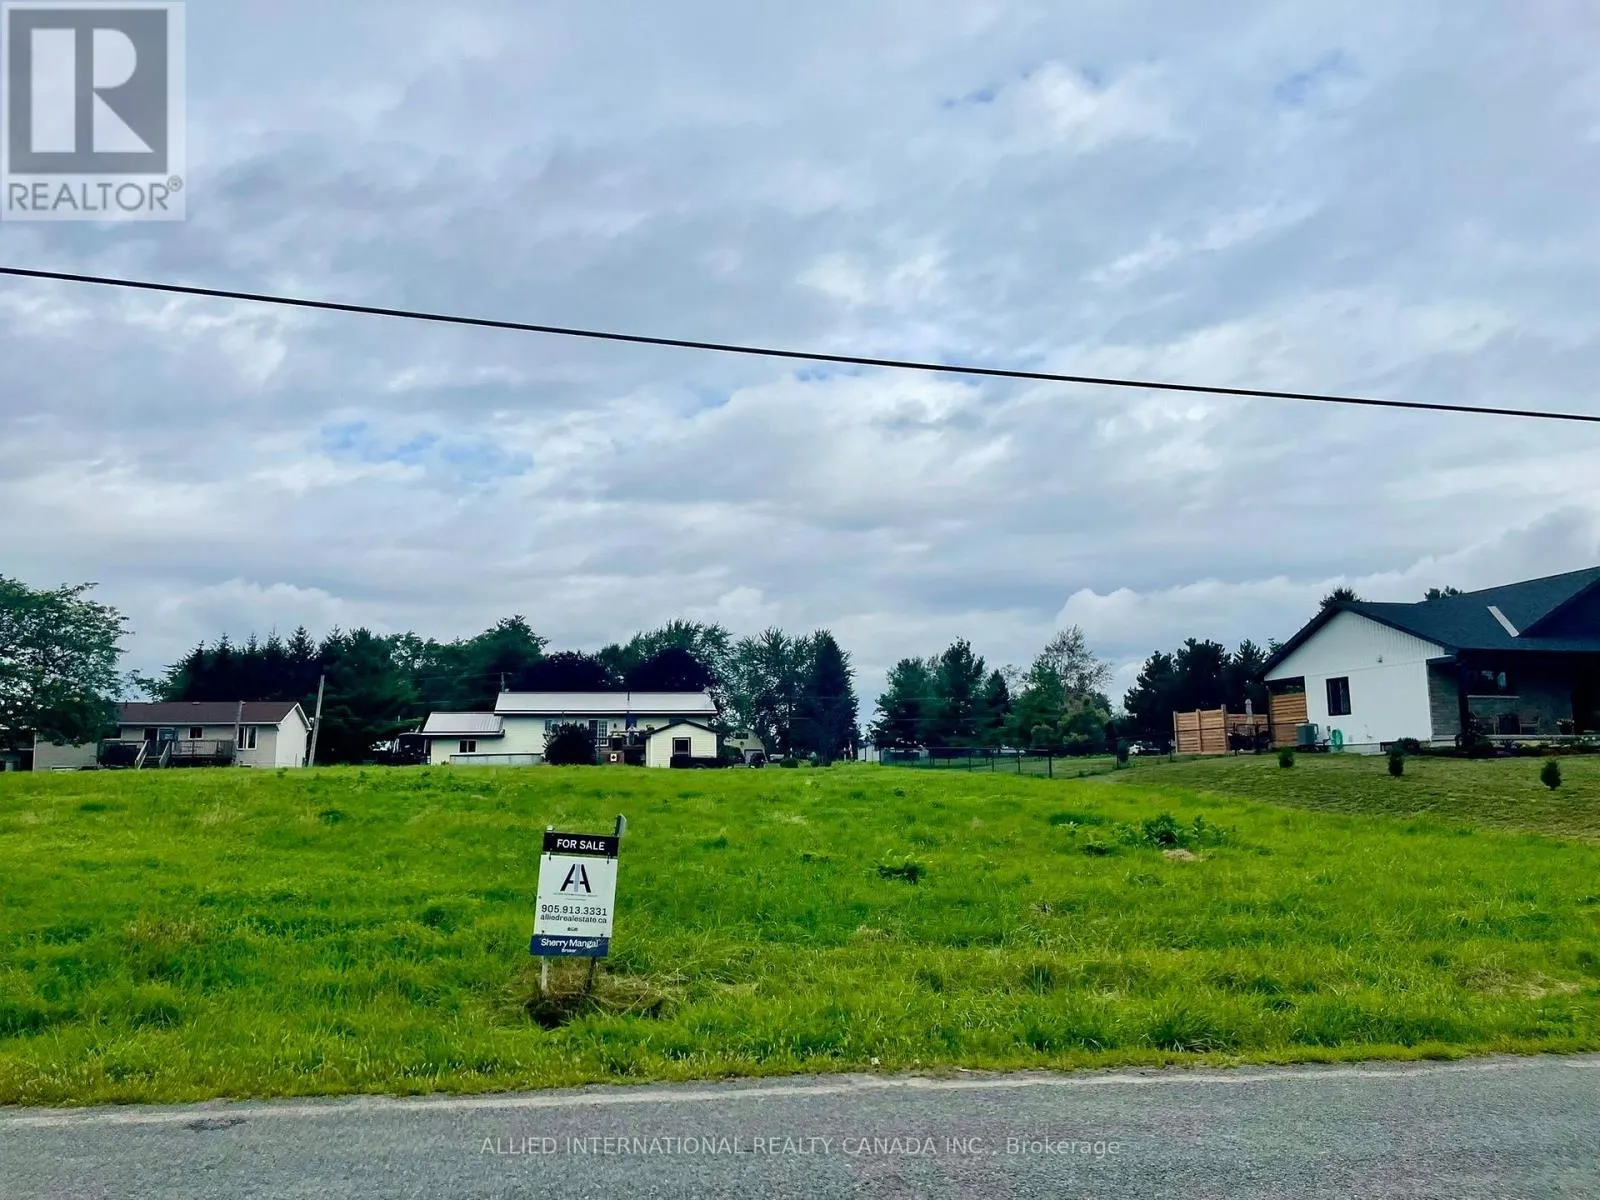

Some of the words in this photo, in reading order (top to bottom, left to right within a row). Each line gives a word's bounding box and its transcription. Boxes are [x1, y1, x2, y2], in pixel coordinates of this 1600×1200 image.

[556, 839, 577, 849] FOR
[579, 840, 606, 851] SALE
[541, 904, 607, 916] 905.913.3331
[540, 914, 608, 924] alliedrealestate.ca
[540, 938, 569, 949] Sherry
